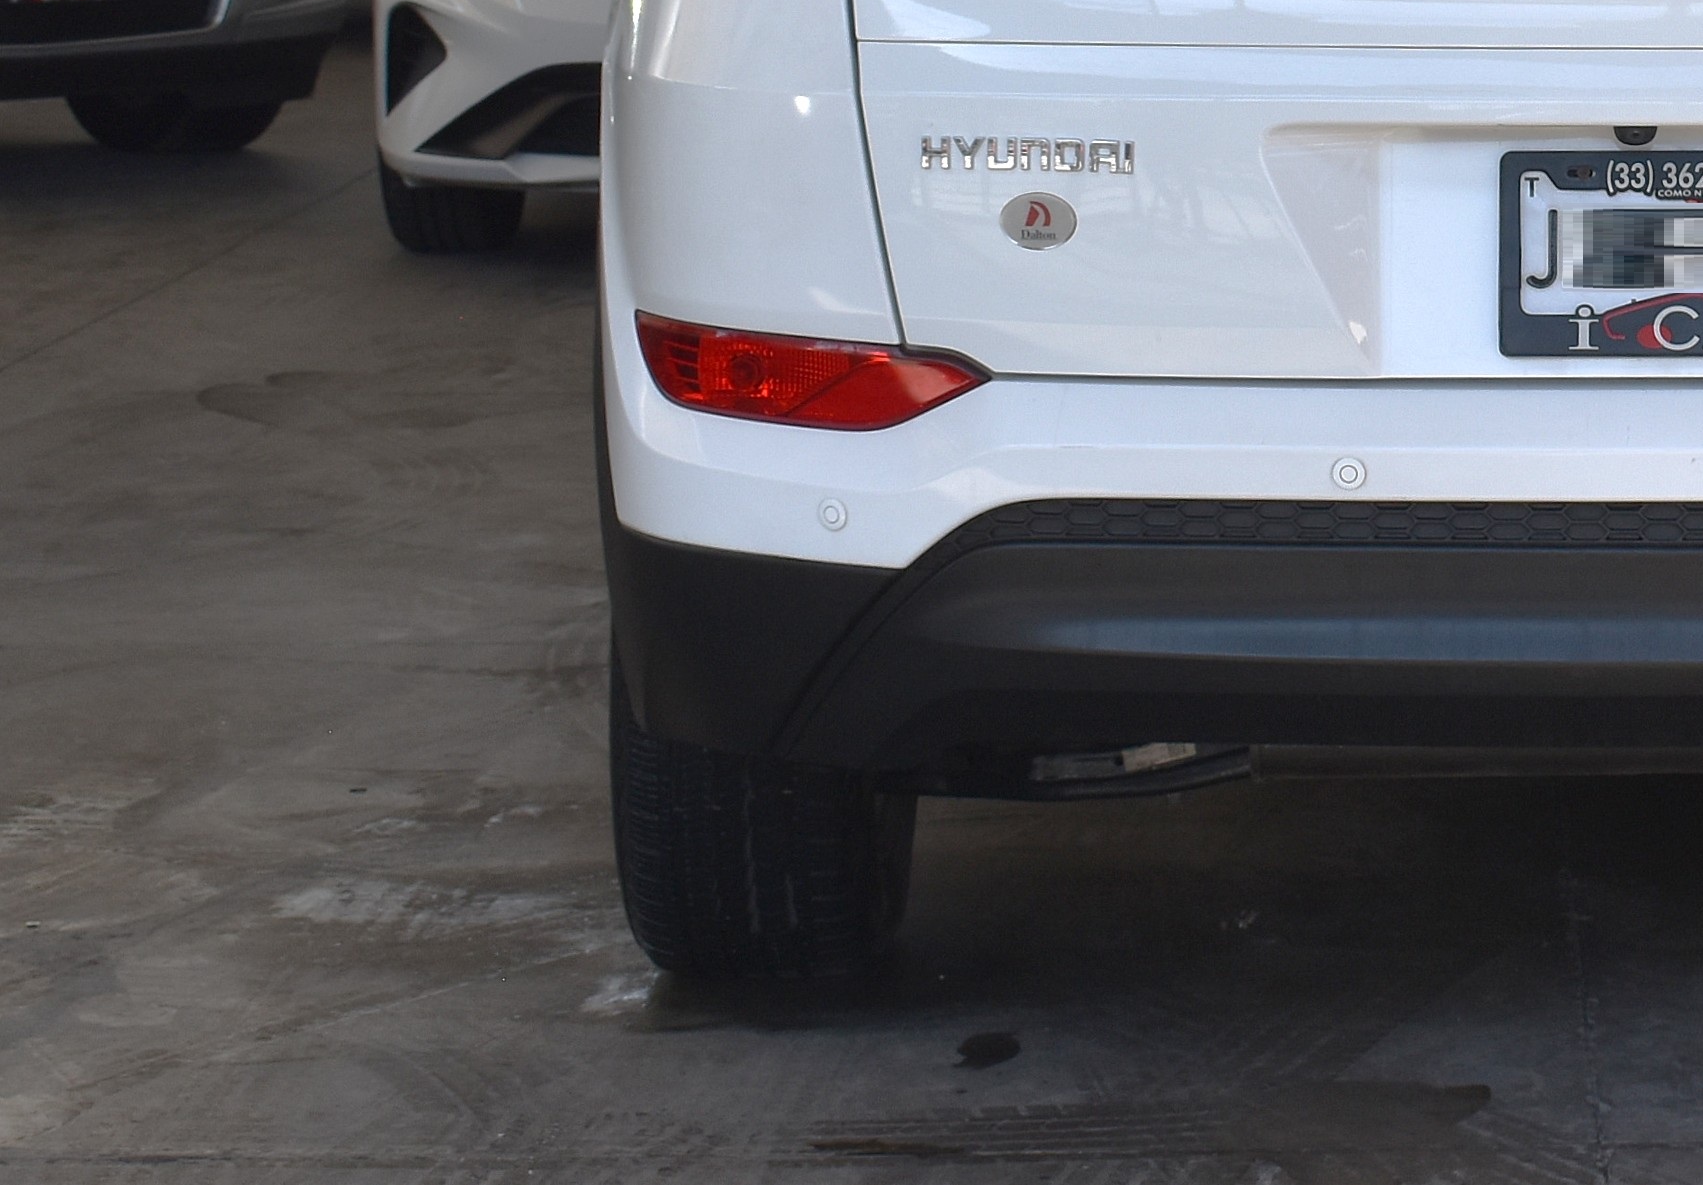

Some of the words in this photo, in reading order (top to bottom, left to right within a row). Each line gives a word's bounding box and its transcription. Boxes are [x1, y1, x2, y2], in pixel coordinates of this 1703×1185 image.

[920, 135, 1135, 175] HYUNDAI
[1606, 159, 1654, 194] (33)
[1657, 189, 1691, 198] COMO
[1020, 229, 1057, 240] Dalton
